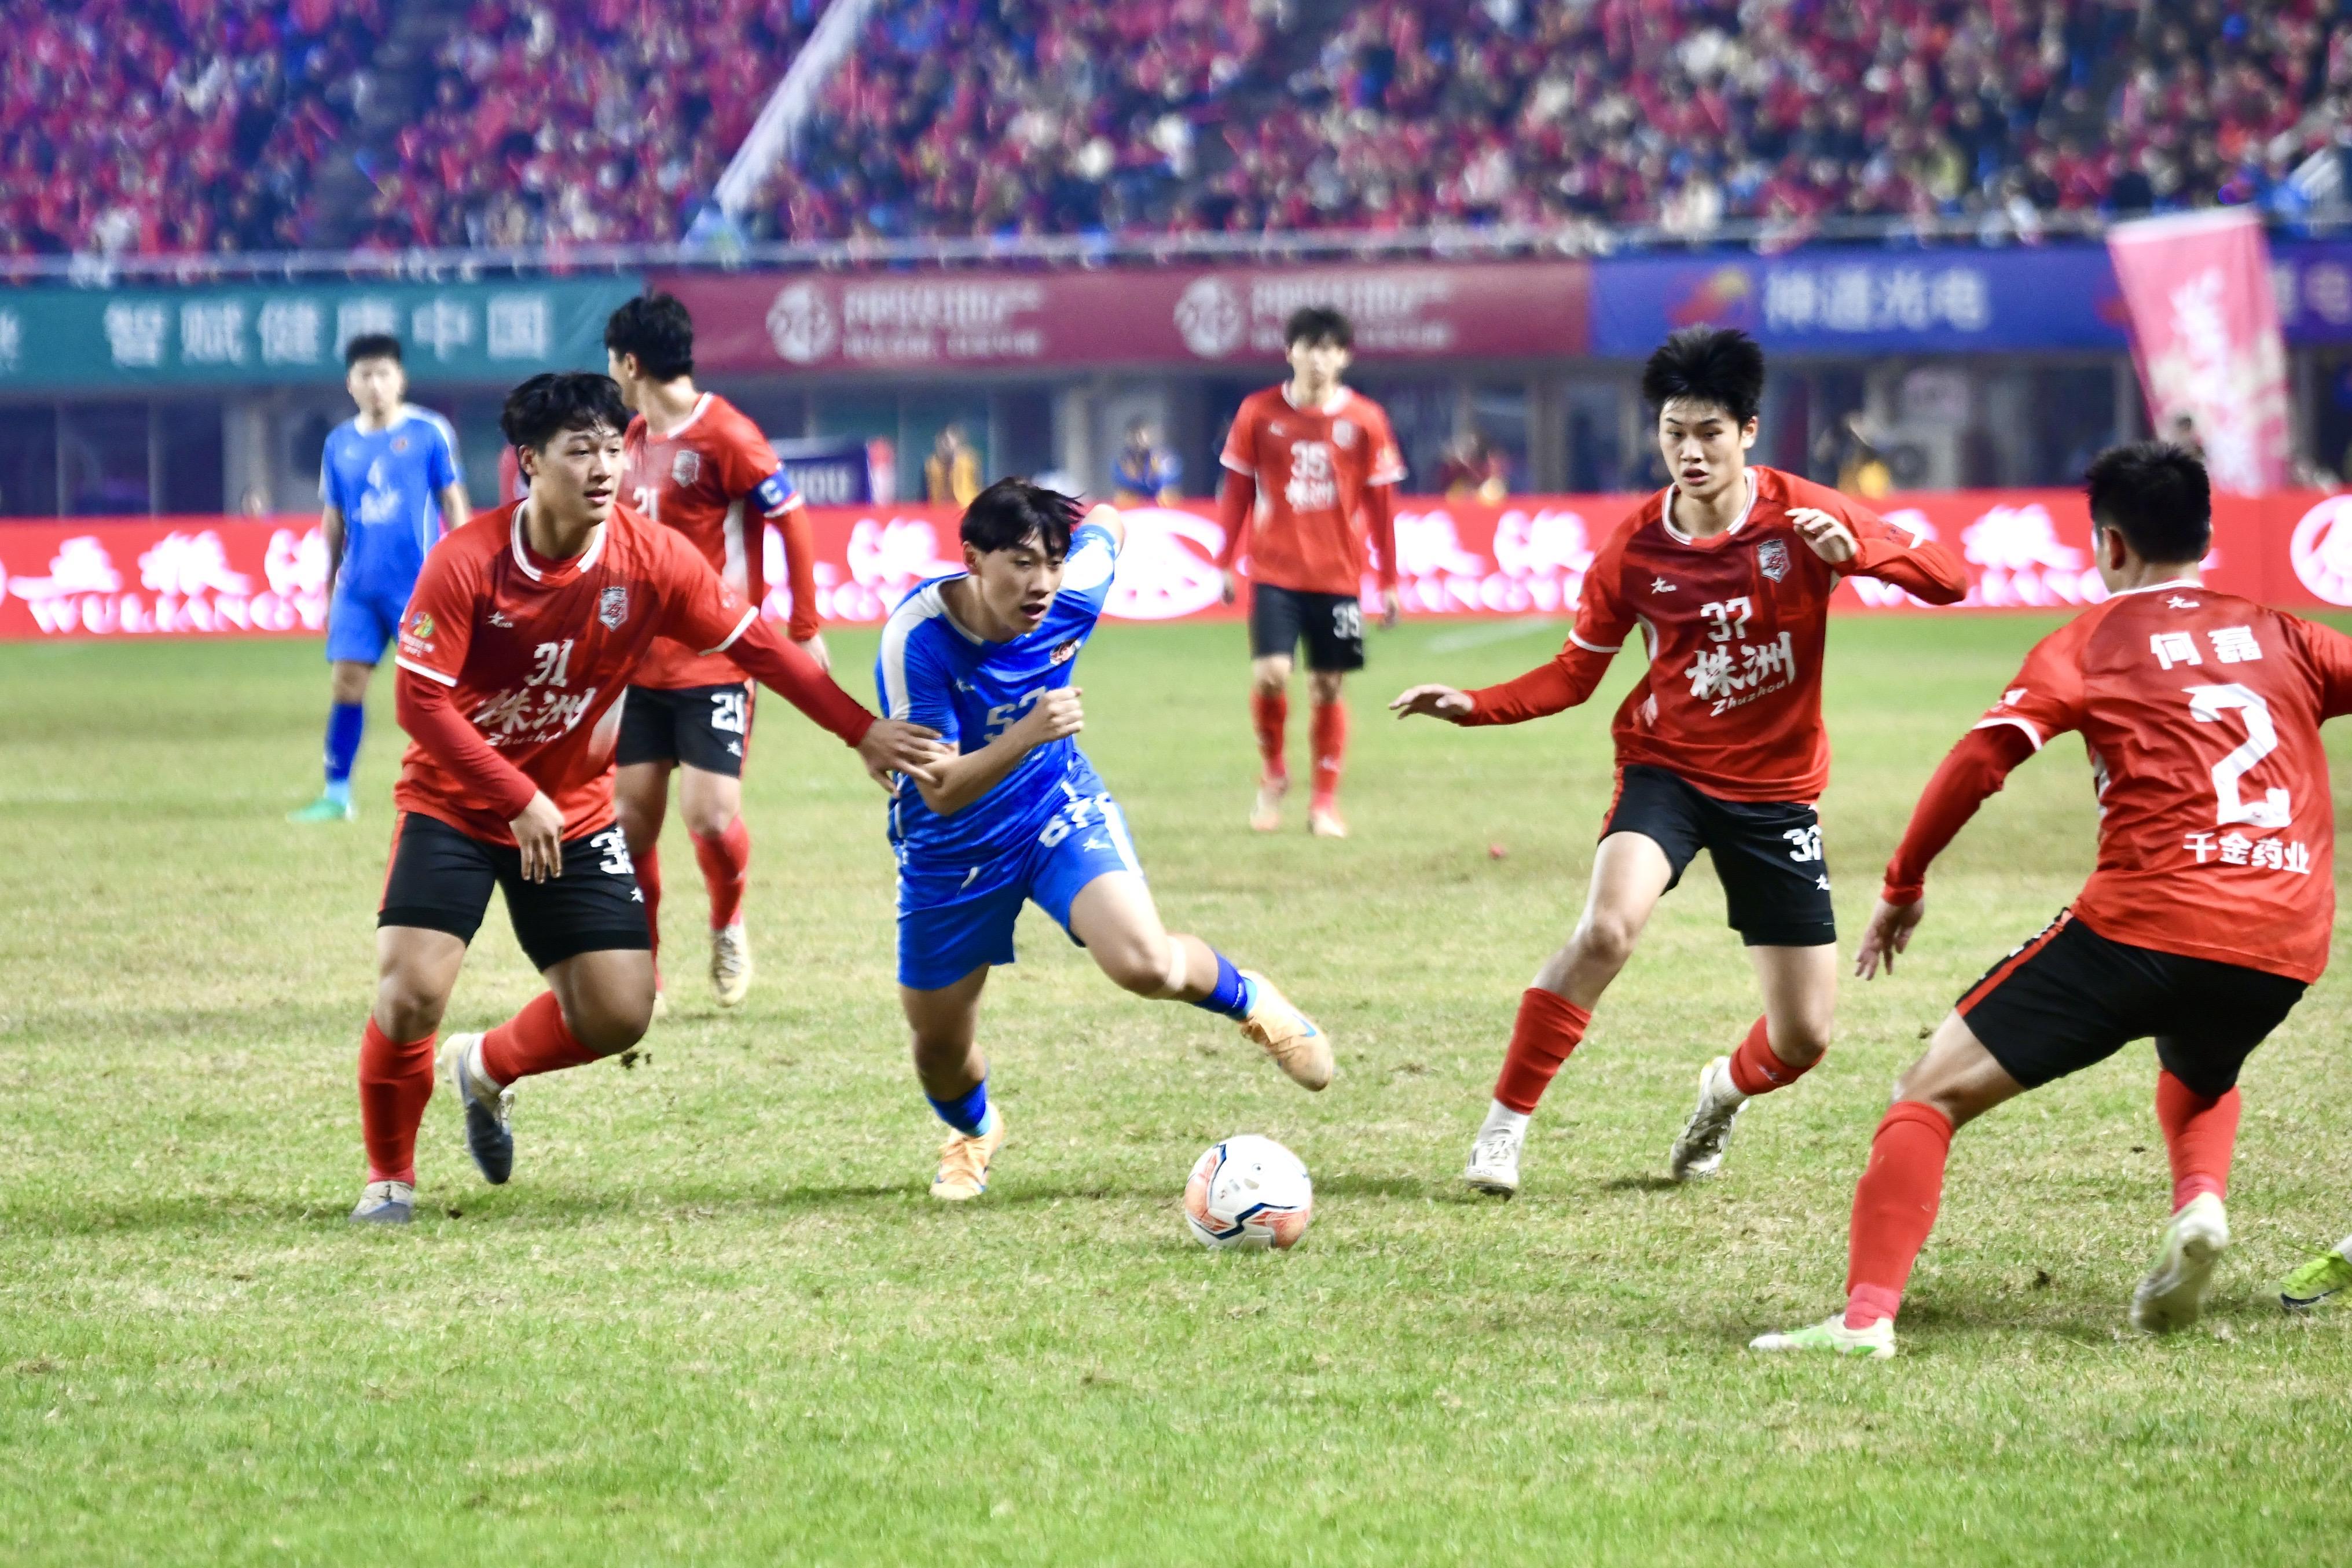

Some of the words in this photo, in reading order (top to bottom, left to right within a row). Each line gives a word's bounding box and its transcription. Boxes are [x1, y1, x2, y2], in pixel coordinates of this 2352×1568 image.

[1290, 440, 1327, 479] 35
[633, 487, 658, 522] 21
[1332, 603, 1360, 639] 35
[1700, 596, 1753, 642] 37
[526, 638, 574, 688] 31
[1684, 631, 1795, 700] 株洲
[2149, 625, 2262, 670] 何磊
[473, 687, 597, 734] 株洲
[710, 692, 744, 736] 21
[1709, 678, 1786, 717] Zhuzhou
[2181, 683, 2292, 828] 2
[1783, 824, 1822, 862] 37
[2182, 832, 2310, 875] 千金药业
